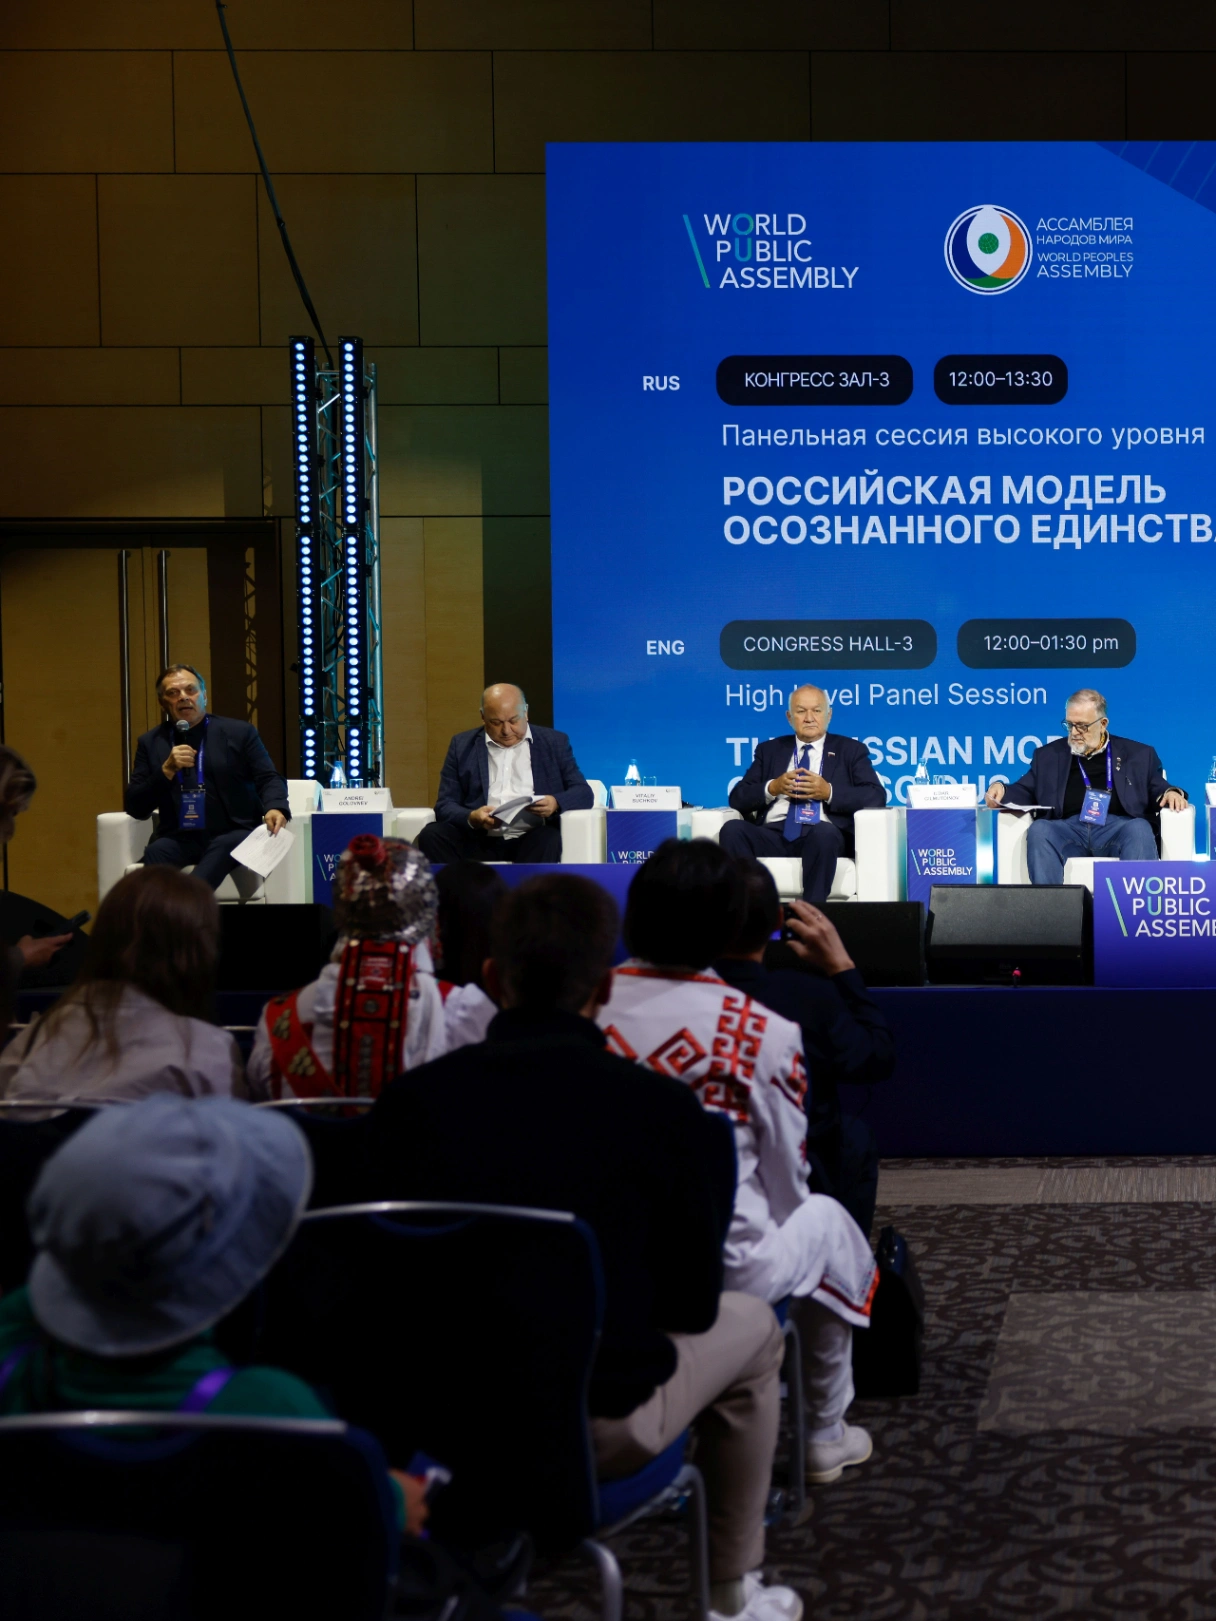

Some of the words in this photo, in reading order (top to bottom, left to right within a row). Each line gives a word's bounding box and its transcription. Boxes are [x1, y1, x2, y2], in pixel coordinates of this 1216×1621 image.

[704, 214, 806, 235] WORLD
[1036, 218, 1133, 231] АССАМБЛЕЯ
[1036, 235, 1096, 246] НАРОДОВ
[1098, 235, 1133, 245] МИРА
[717, 238, 812, 262] PUBLIC
[1038, 252, 1081, 262] WORLD
[1083, 252, 1134, 262] PEOPLES
[720, 267, 859, 288] ASSEMBLY
[1037, 265, 1132, 278] ASSEMBLY
[643, 376, 680, 390] RUS
[746, 372, 834, 387] КОНГРЕСС
[839, 372, 889, 387] ЗАЛ-3
[723, 425, 865, 446] Панельная
[876, 428, 967, 445] сессия
[978, 428, 1102, 445] высокого
[1112, 428, 1204, 449] уровня
[724, 469, 991, 505] РОССИЙСКАЯ
[1003, 475, 1166, 510] МОДЕЛЬ
[724, 515, 1020, 544] ОСОЗНАННОГО
[647, 640, 684, 655] ENG
[744, 636, 843, 651] CONGRESS
[850, 636, 912, 651] HALL-3
[1093, 638, 1118, 654] pm
[727, 684, 783, 711] High
[793, 684, 860, 706] vel
[870, 684, 938, 705] Panel
[949, 683, 1046, 705] Session
[855, 736, 973, 766] SSIAN
[918, 849, 955, 857] WORLD
[922, 857, 957, 866] PUBLIC
[923, 867, 973, 875] ASSEMBLY
[1122, 877, 1207, 895] WORLD
[1132, 896, 1211, 916] PUBLIC
